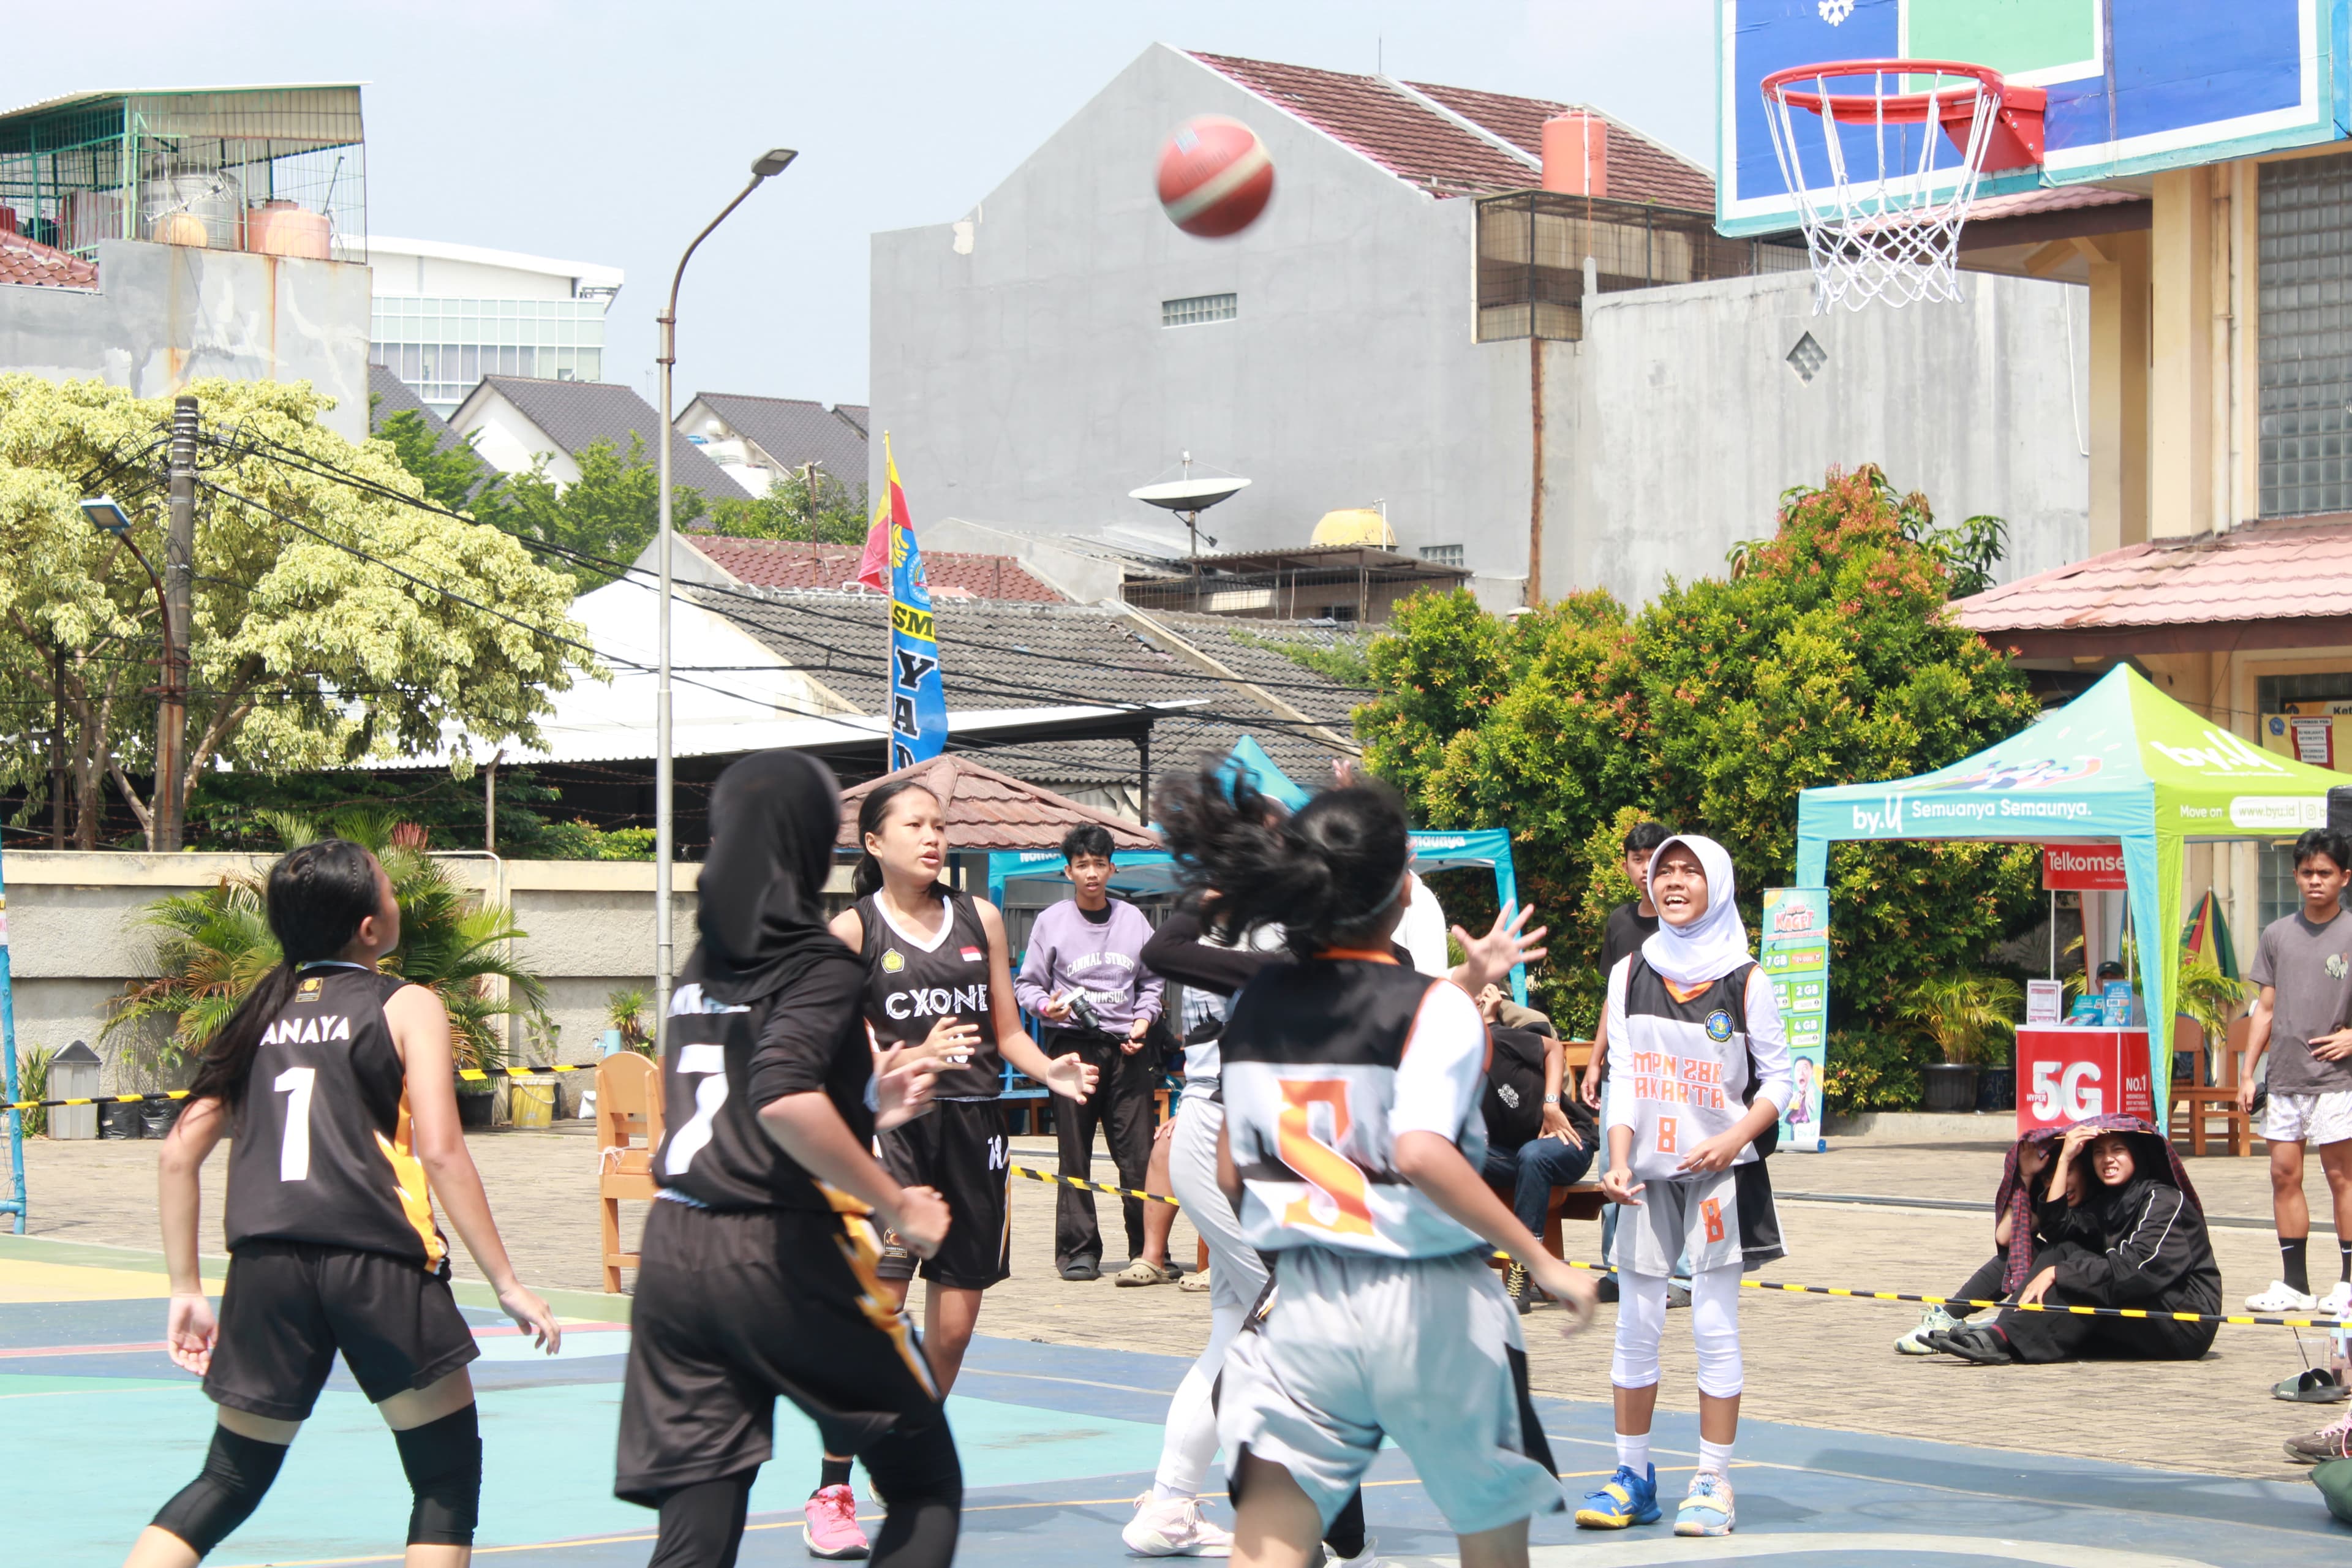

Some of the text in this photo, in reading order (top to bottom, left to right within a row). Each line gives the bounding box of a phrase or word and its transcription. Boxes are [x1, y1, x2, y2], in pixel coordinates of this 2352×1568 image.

[893, 605, 936, 640] SM
[1911, 800, 1996, 820] Semuanya
[2000, 798, 2092, 820] Semaunya.
[2179, 804, 2222, 818] Move on
[2239, 805, 2295, 820] www.byu.id
[1105, 951, 1135, 974] STREET
[885, 984, 989, 1020] CXONE
[2026, 1093, 2047, 1102] HYPER
[2032, 1061, 2103, 1121] 5G
[2126, 1074, 2146, 1092] NO.1
[273, 1066, 317, 1182] 1
[663, 1043, 729, 1176] 7
[1655, 1115, 1679, 1155] 8
[1699, 1197, 1725, 1243] 8
